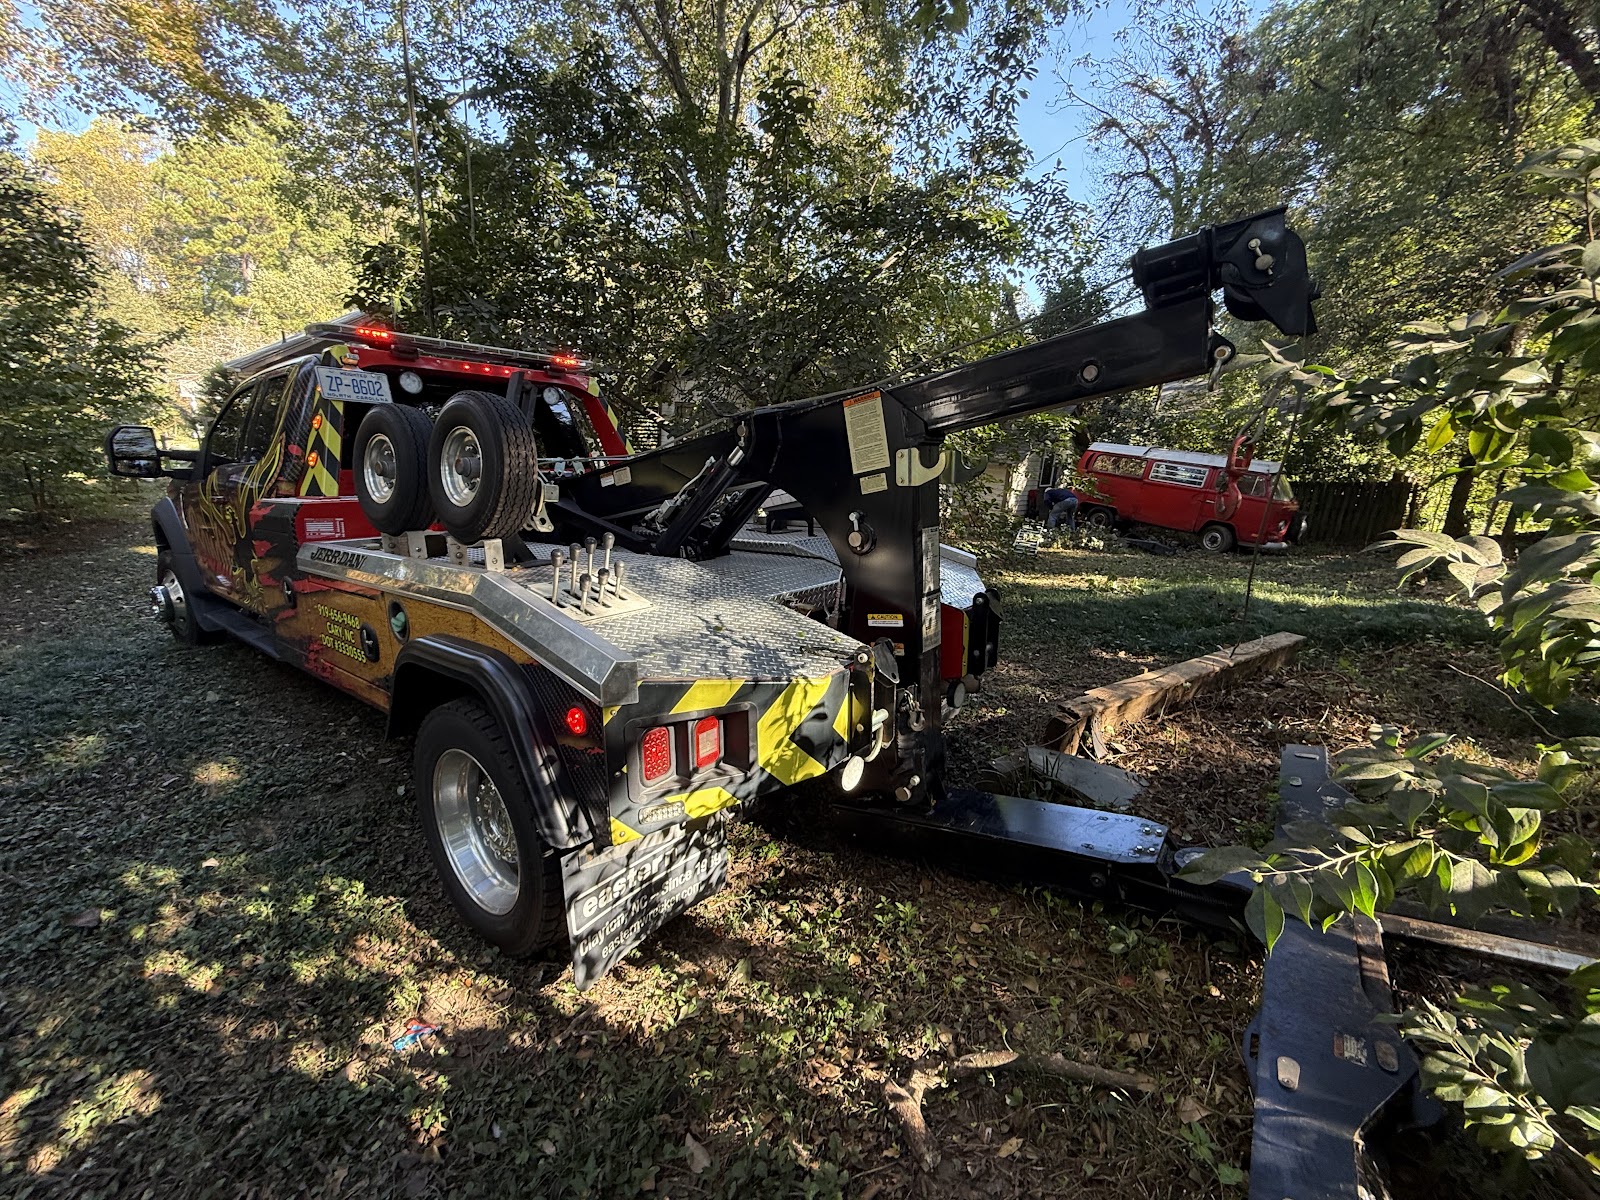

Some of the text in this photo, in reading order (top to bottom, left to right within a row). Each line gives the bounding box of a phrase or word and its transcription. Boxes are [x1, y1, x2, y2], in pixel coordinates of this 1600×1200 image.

[326, 375, 384, 397] ZP-8602
[317, 603, 360, 629] 919-656-9468
[327, 621, 355, 643] CARY, NC
[321, 633, 366, 663] DOT #3330555
[583, 847, 678, 918] eastern
[579, 912, 628, 957] Clayton,
[630, 894, 648, 917] NC
